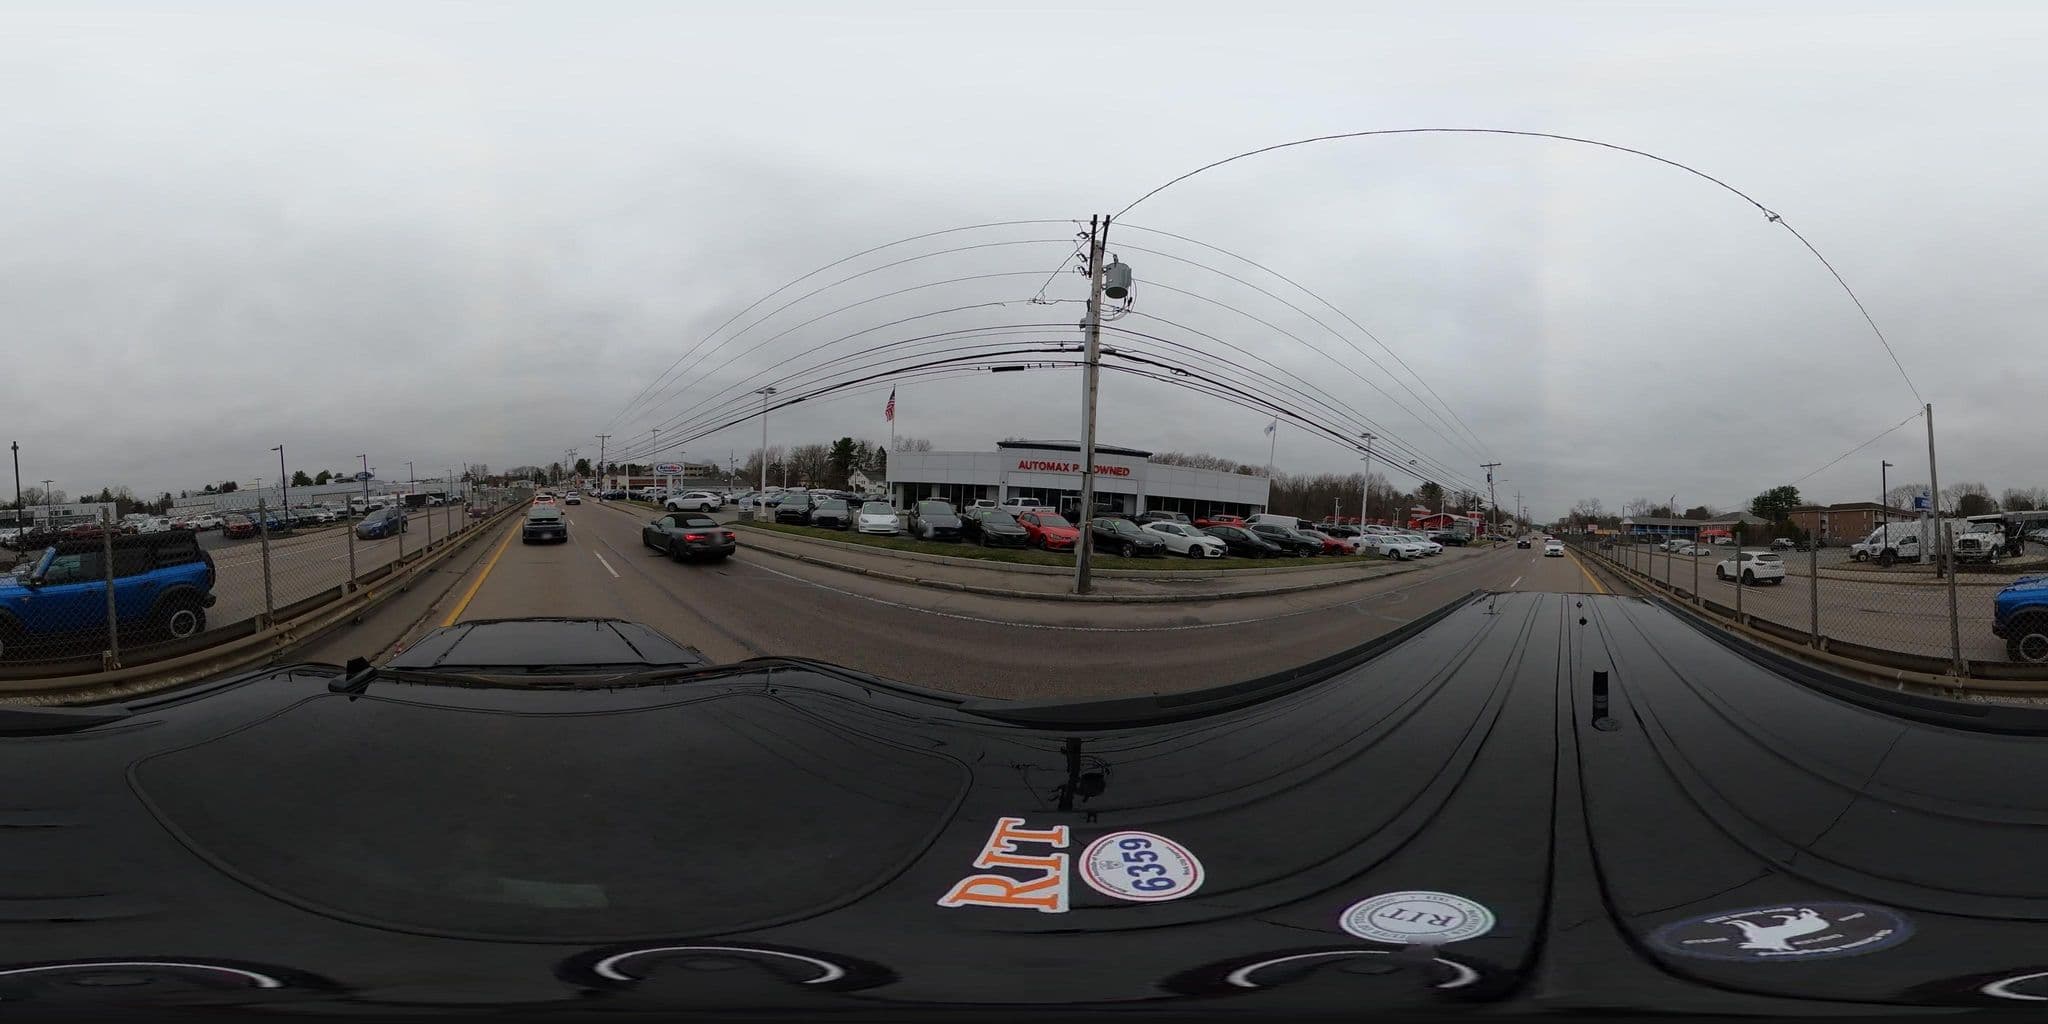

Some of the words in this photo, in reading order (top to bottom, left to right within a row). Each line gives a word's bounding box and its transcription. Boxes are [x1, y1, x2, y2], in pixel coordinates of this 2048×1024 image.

[1018, 460, 1070, 472] AUTOMAX
[949, 818, 1065, 910] RIT
[1118, 837, 1175, 892] 6359
[1378, 908, 1455, 927] RIT
